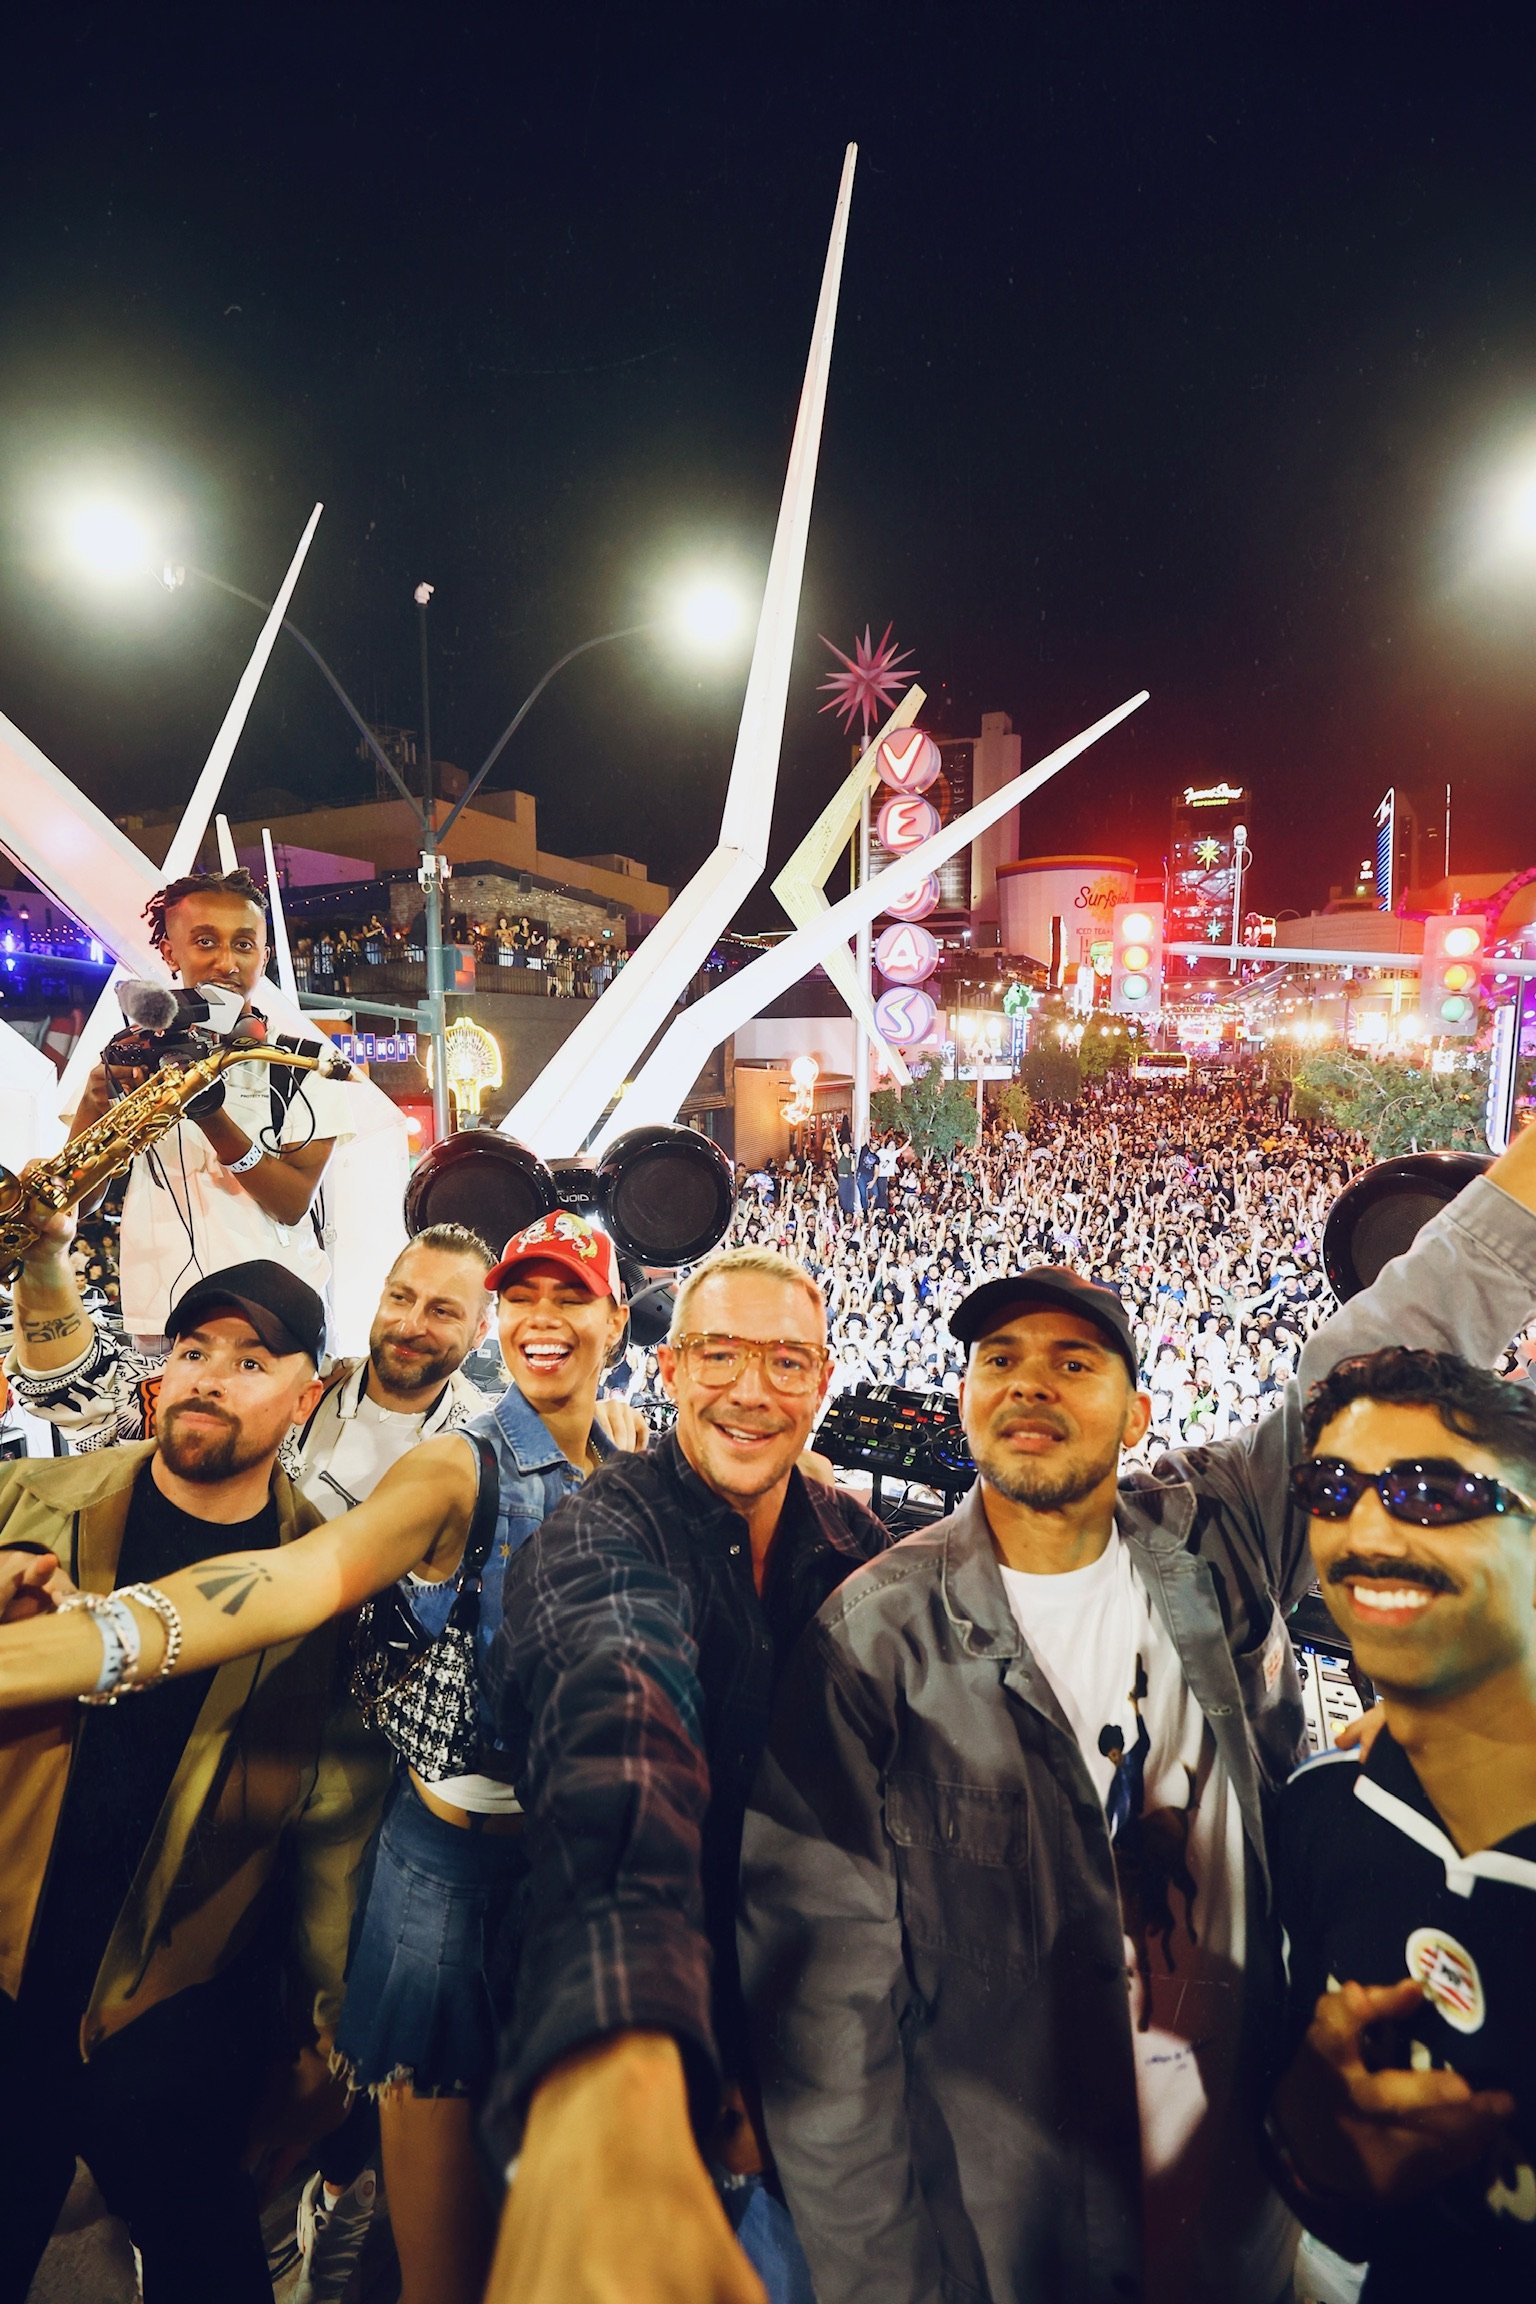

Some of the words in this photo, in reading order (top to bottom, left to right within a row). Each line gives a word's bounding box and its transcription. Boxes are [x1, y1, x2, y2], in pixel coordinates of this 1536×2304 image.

[1076, 927, 1092, 935] ICED
[1094, 927, 1106, 935] TEA
[343, 1041, 415, 1056] FREMONT
